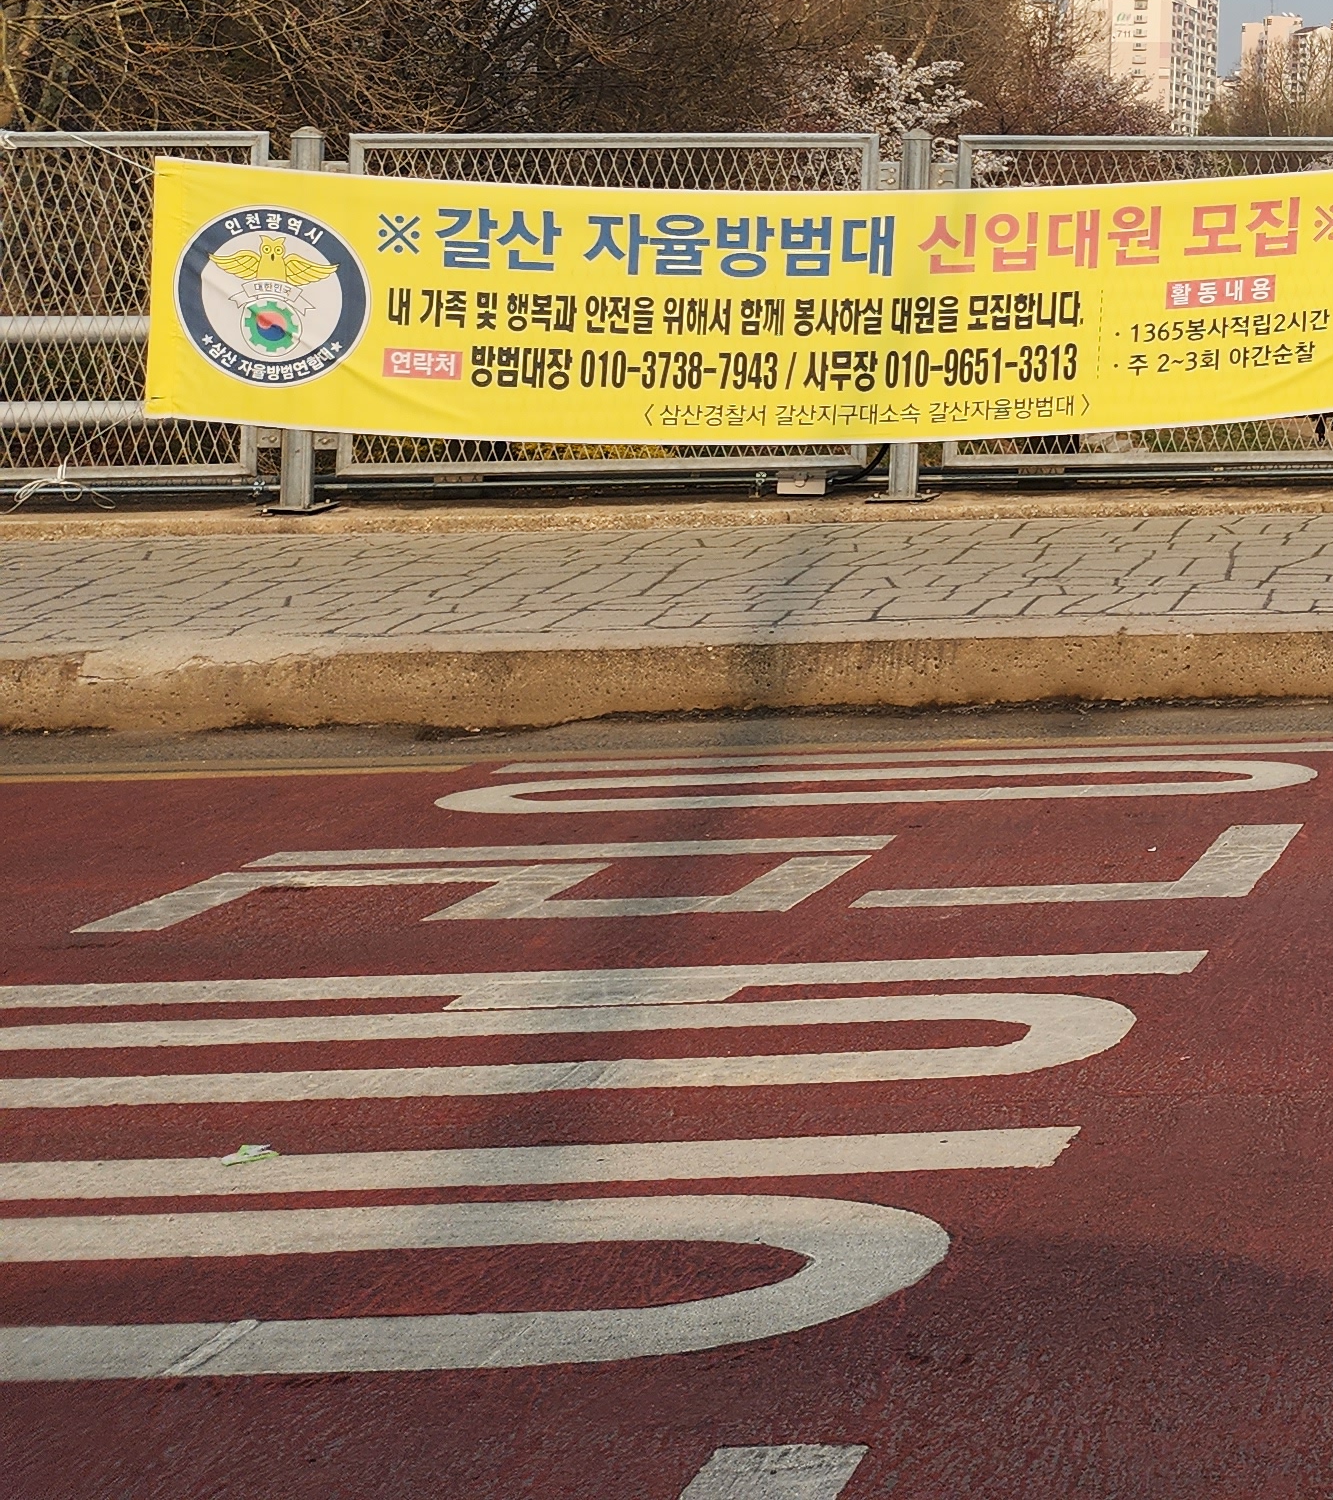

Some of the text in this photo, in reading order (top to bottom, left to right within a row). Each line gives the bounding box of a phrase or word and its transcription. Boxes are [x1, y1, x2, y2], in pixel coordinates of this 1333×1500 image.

[224, 212, 323, 245] 인천광역시
[434, 208, 563, 272] 갈산
[583, 213, 895, 278] 자율방범대
[917, 206, 1162, 275] 신입대원
[253, 282, 292, 297] 대한민국
[1170, 277, 1271, 306] 활동내용
[387, 287, 1083, 337] 내 가족 및 행복과 안전을 위해서 함께 봉사하실 대원을 모집합니다.
[1130, 308, 1331, 343] 1365봉사적립2시간
[209, 342, 335, 381] 삼산 자율방범연합대
[390, 351, 456, 377] 연락처
[470, 346, 573, 390] 방범대장
[580, 349, 778, 390] 010-3738-7943
[802, 351, 878, 392] 사무장
[885, 342, 1078, 388] 010-9651-3313
[1127, 340, 1316, 376] 주 2~3회 야간순찰
[774, 402, 921, 426] 갈산지구대소속
